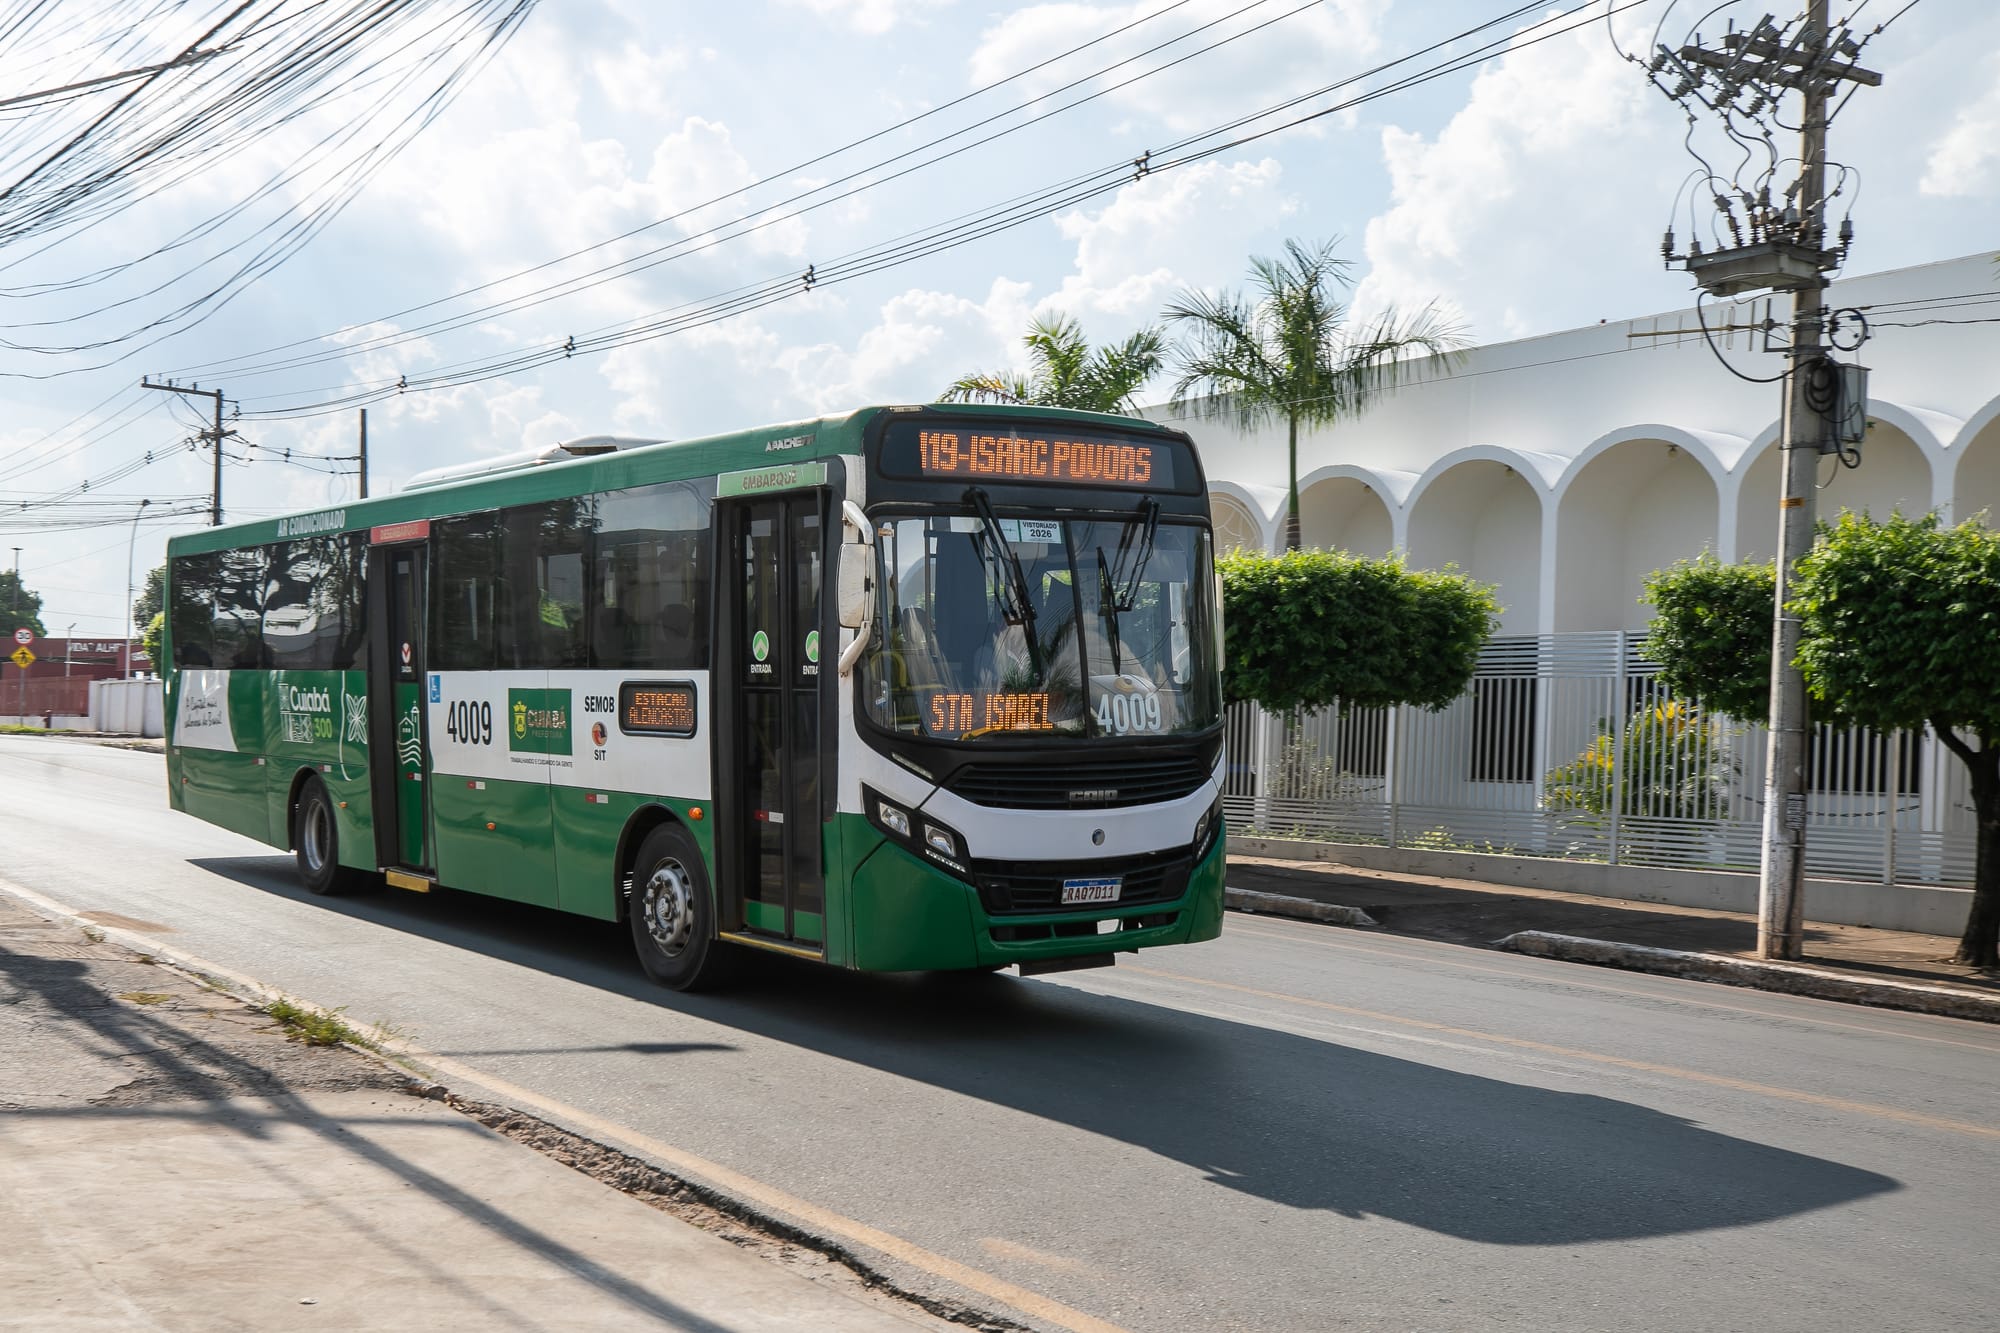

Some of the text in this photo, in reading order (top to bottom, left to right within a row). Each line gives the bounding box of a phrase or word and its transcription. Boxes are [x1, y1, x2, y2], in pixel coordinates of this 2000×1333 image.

[919, 431, 1152, 482] 119-ISAAC POVOAS
[742, 469, 797, 490] EMBARQUE
[277, 510, 345, 537] AR CONDICIONADO
[1022, 521, 1058, 530] VISTORIADO
[1030, 529, 1052, 538] 2026
[750, 664, 772, 674] ENTRADA
[290, 686, 331, 712] Cuiabá
[584, 696, 615, 713] SEMOB
[931, 693, 1053, 731] STA ISABEL
[1098, 693, 1161, 733] 4009
[314, 717, 332, 738] 300
[447, 700, 492, 746] 4009
[594, 749, 606, 761] SIT
